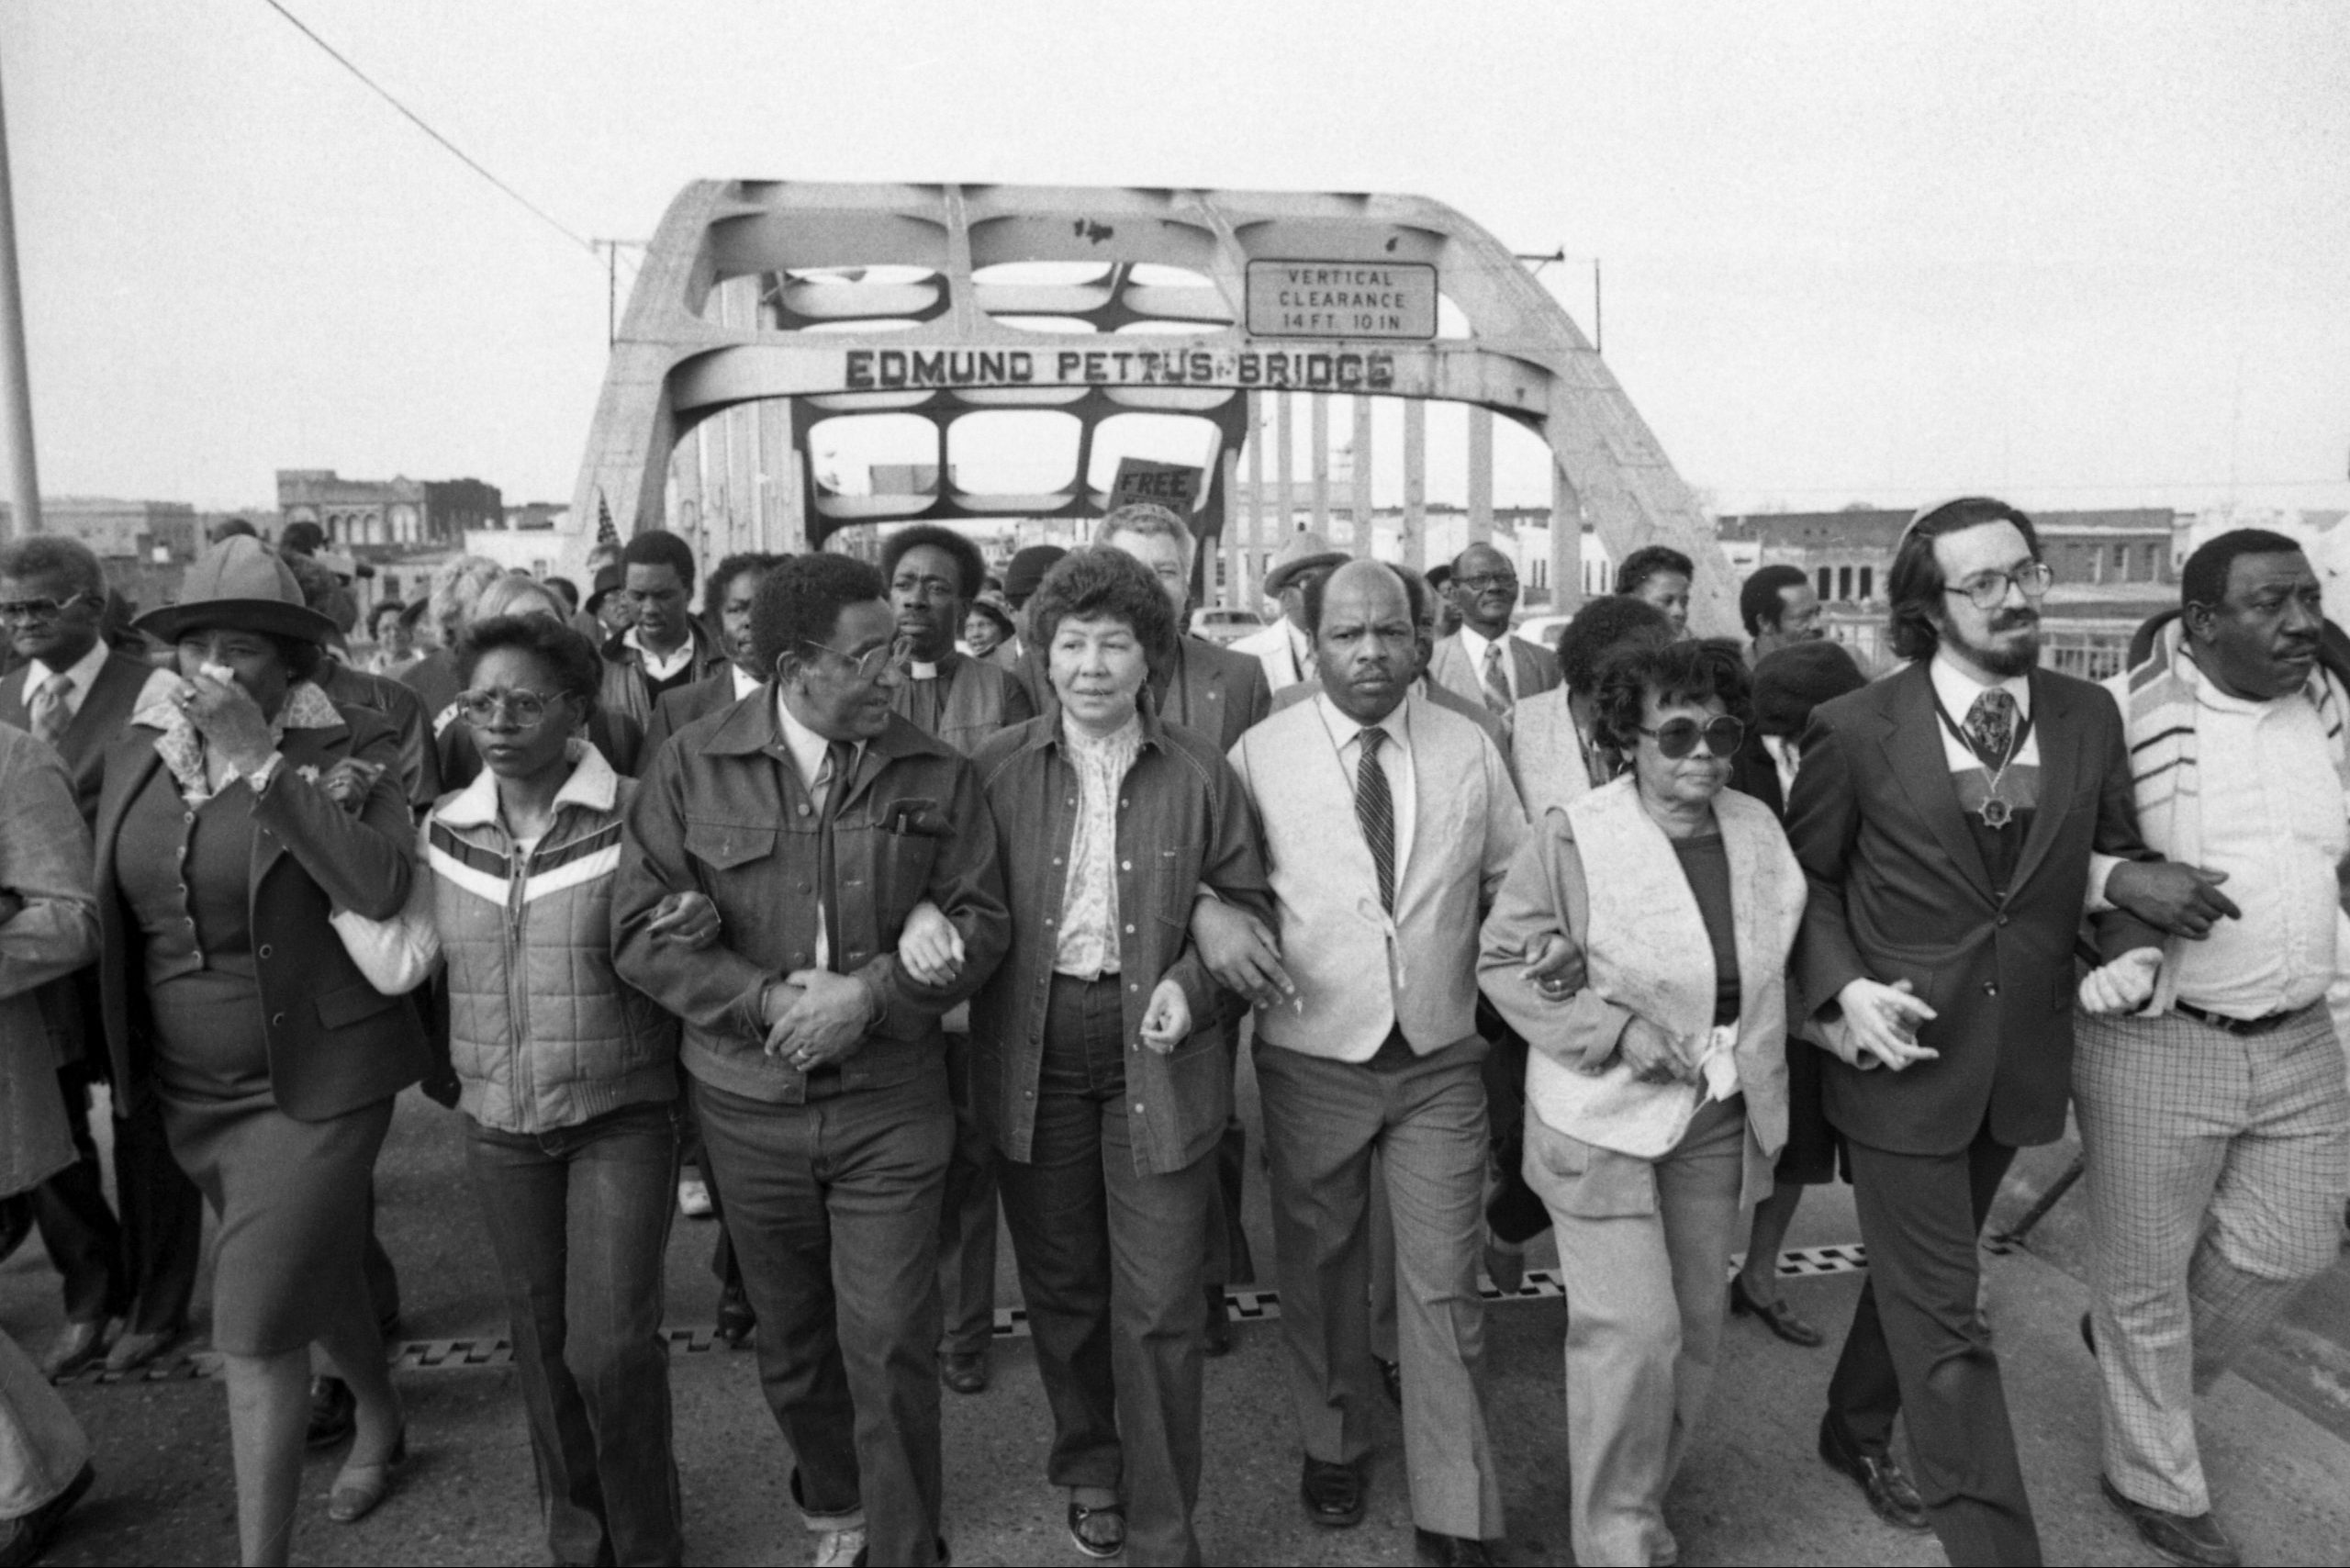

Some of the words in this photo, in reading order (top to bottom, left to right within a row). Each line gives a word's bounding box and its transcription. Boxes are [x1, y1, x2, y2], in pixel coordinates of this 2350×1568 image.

[1288, 269, 1393, 286] VERTICAL
[1279, 290, 1405, 308] CLEARANCE
[845, 350, 1033, 387] EDMUND
[1058, 349, 1213, 382] PETTUS
[1238, 351, 1394, 389] BRIDGE
[1120, 468, 1192, 498] FREE
